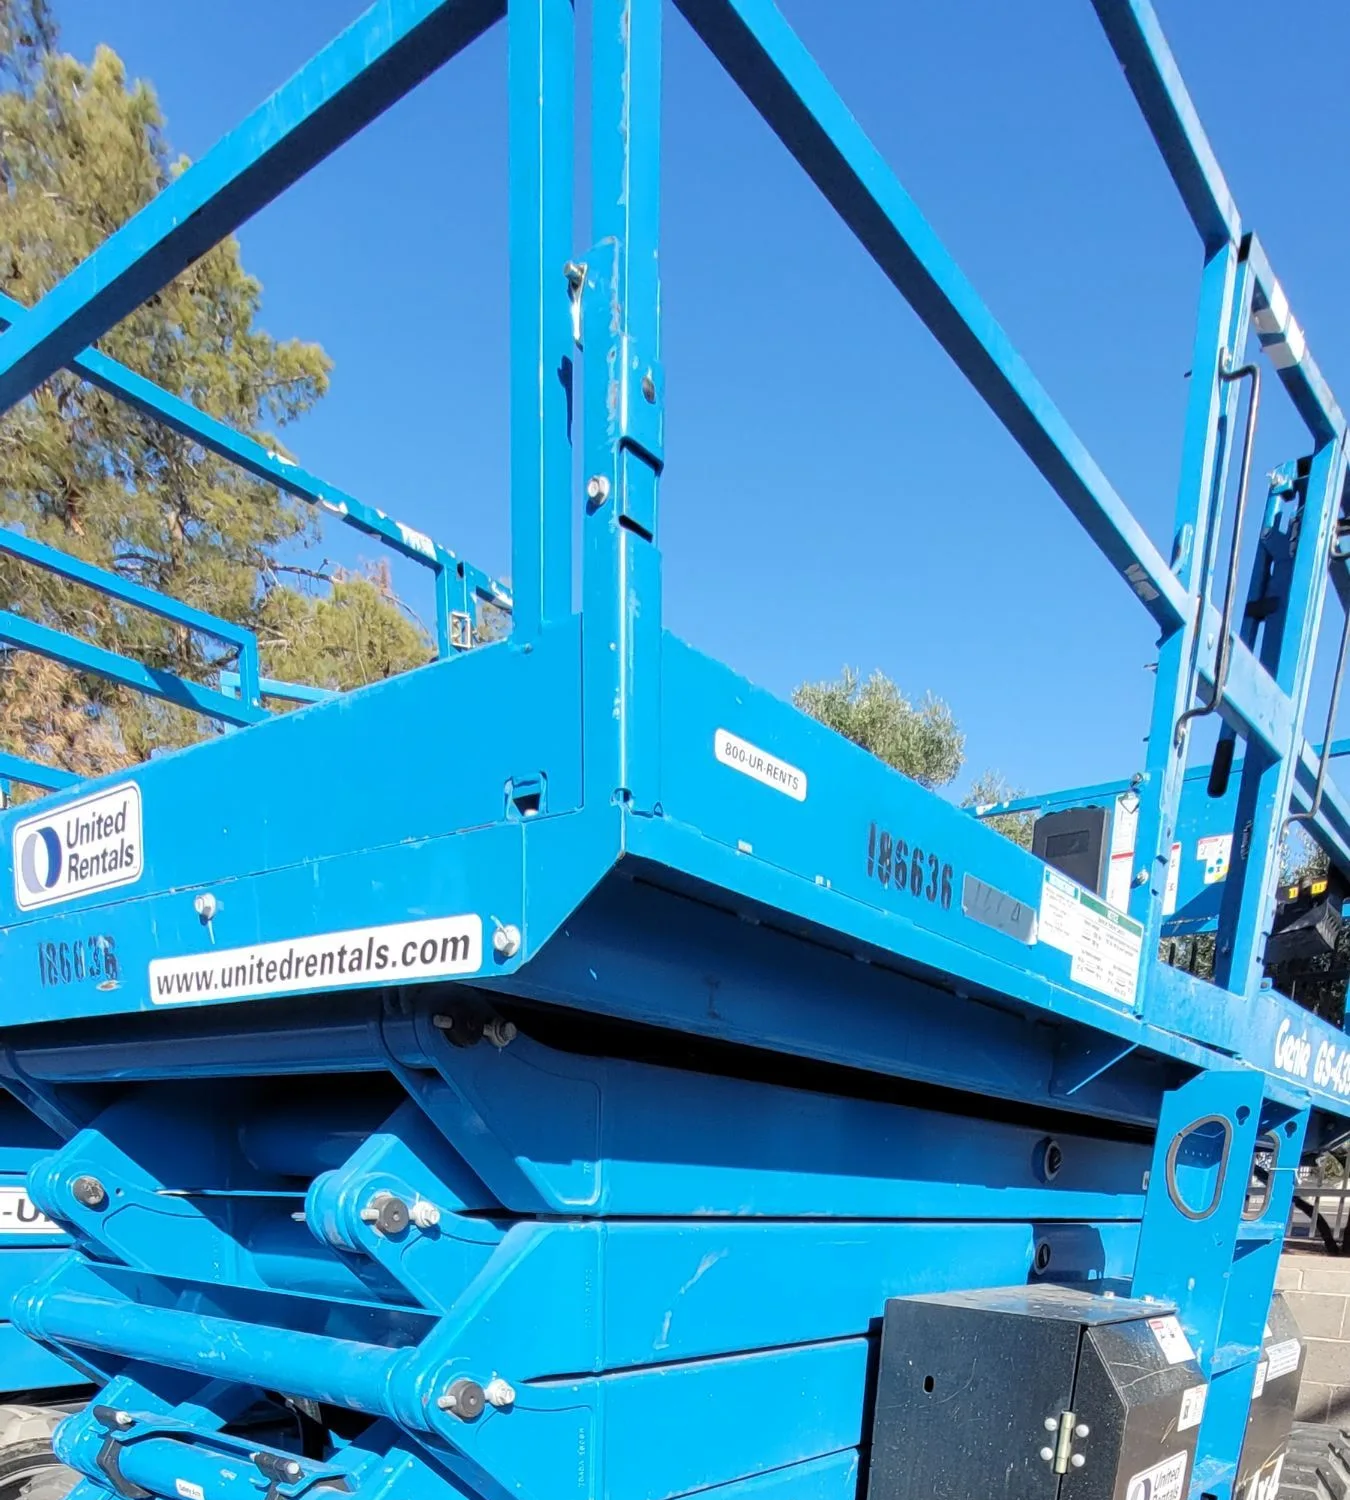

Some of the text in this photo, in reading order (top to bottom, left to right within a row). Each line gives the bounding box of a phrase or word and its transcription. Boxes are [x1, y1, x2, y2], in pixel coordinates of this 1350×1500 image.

[725, 742, 799, 790] 800-UR-RENTS
[66, 801, 127, 849] United
[68, 838, 135, 884] Rentals
[867, 821, 953, 911] 186636
[157, 933, 470, 996] www.unitedrentals.com
[1275, 1017, 1311, 1078] Genie
